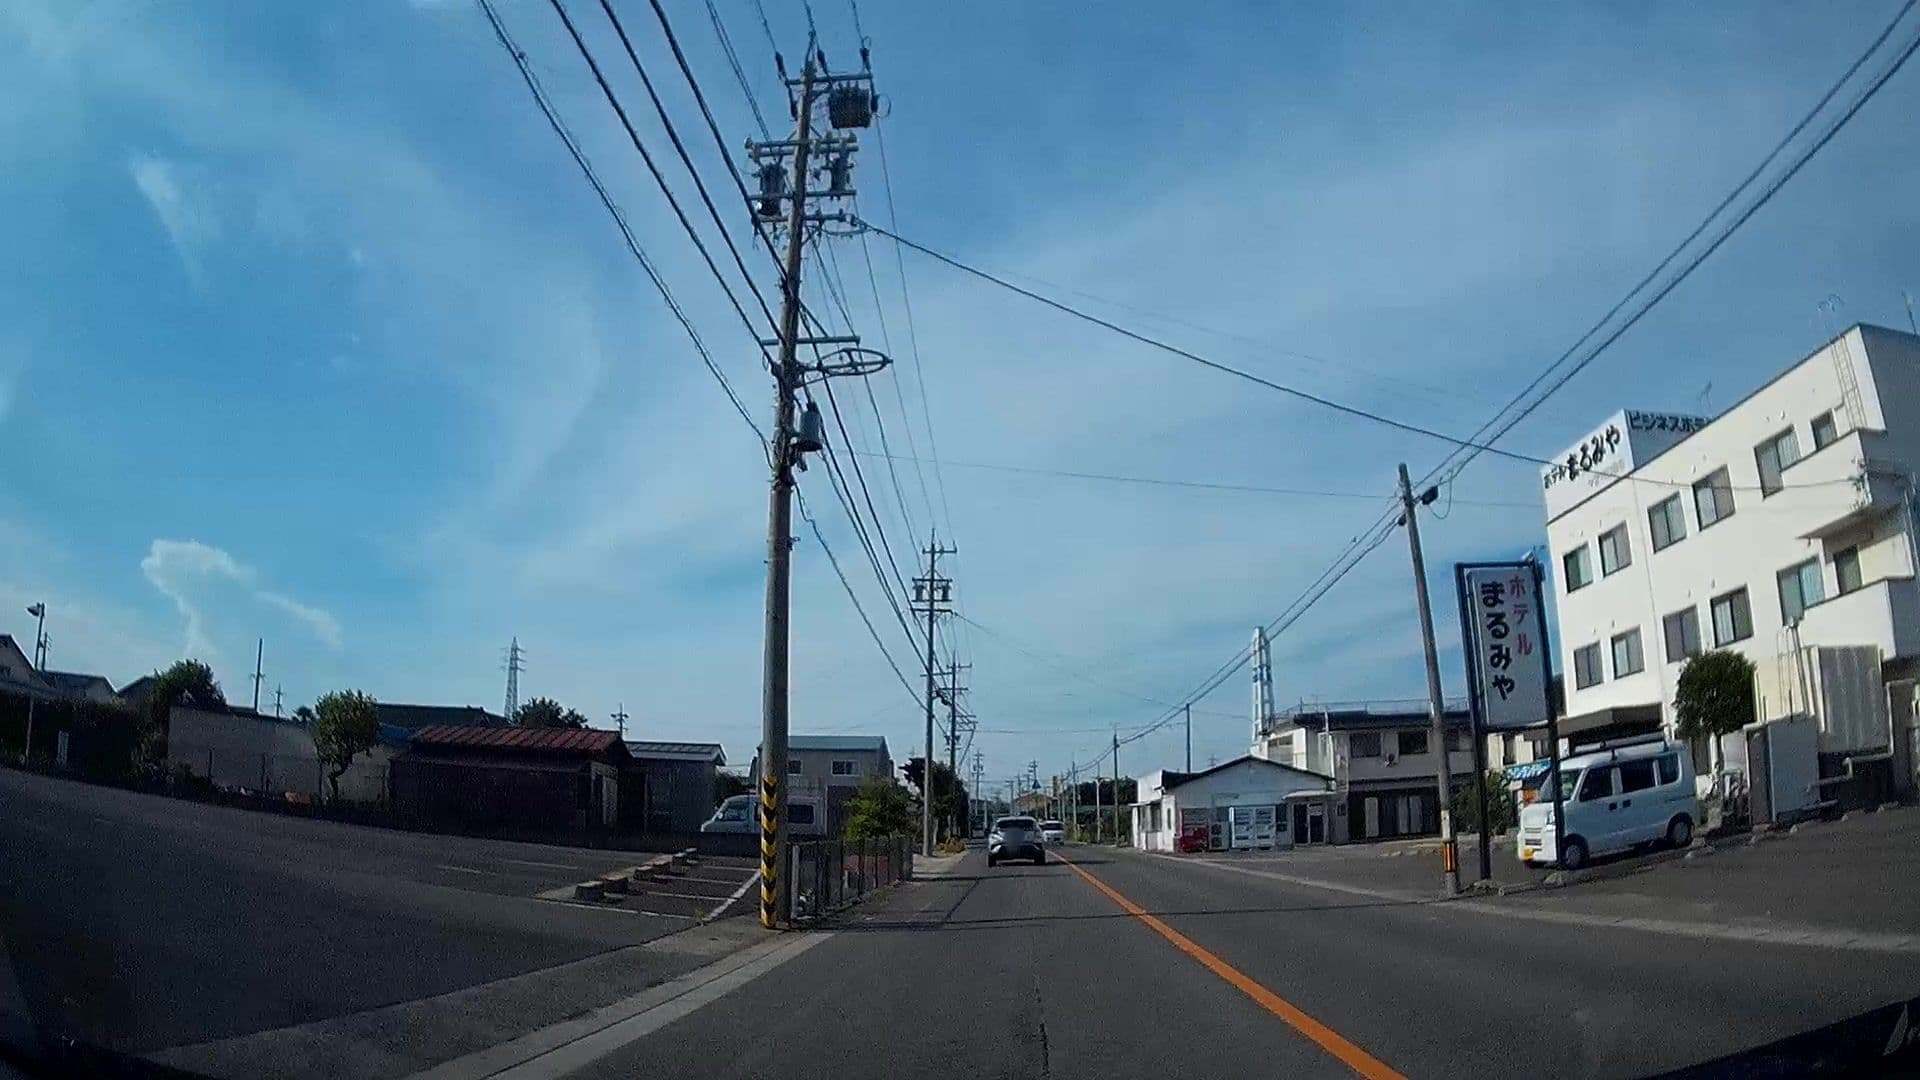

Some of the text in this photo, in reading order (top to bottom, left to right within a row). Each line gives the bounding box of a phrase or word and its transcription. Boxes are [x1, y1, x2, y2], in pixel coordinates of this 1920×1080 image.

[1543, 465, 1567, 489] ホテル
[1567, 424, 1621, 481] まるみや
[1628, 410, 1711, 432] ビジネスホテ
[1481, 581, 1515, 701] まるみや
[1509, 575, 1533, 656] ホテル
